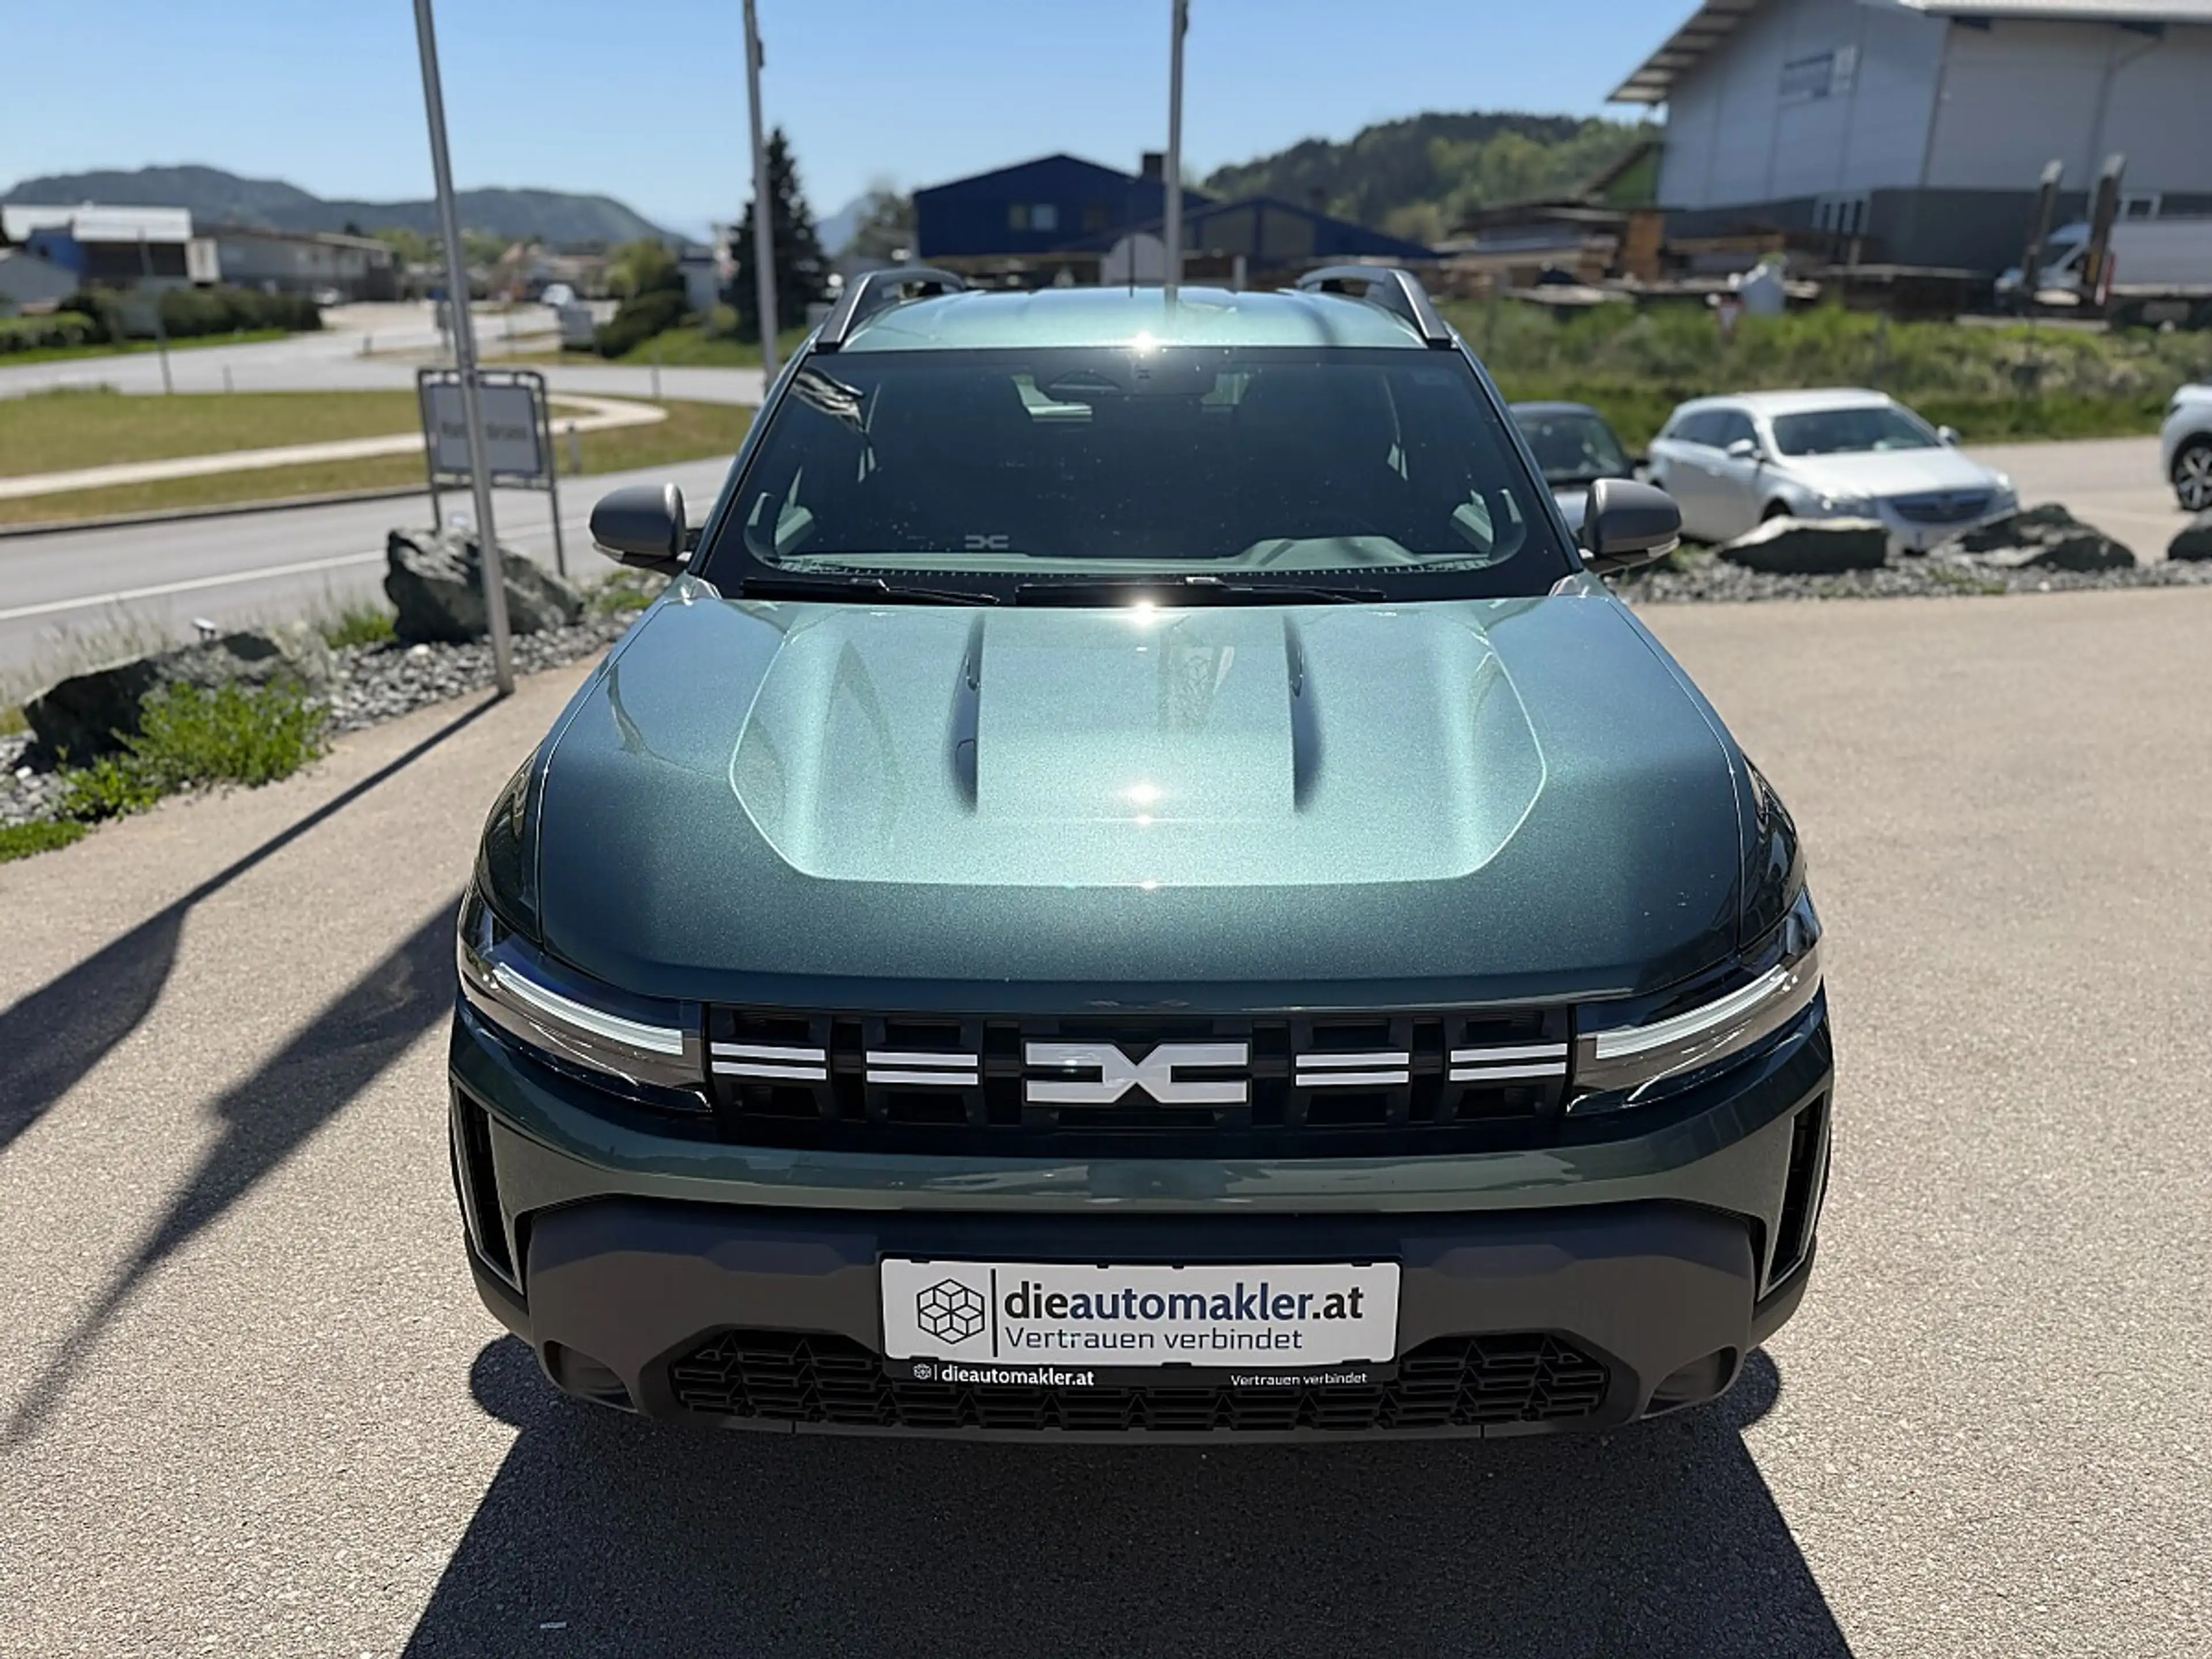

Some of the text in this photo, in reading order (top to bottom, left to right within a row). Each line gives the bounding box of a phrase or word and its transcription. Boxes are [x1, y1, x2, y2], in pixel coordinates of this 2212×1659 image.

[1004, 1281, 1363, 1321] dieautomakler.at
[1005, 1327, 1302, 1349] Vertrauen verbindet
[941, 1365, 1094, 1385] dieautomakler.at
[1230, 1372, 1368, 1385] Vertrauen verbindet
